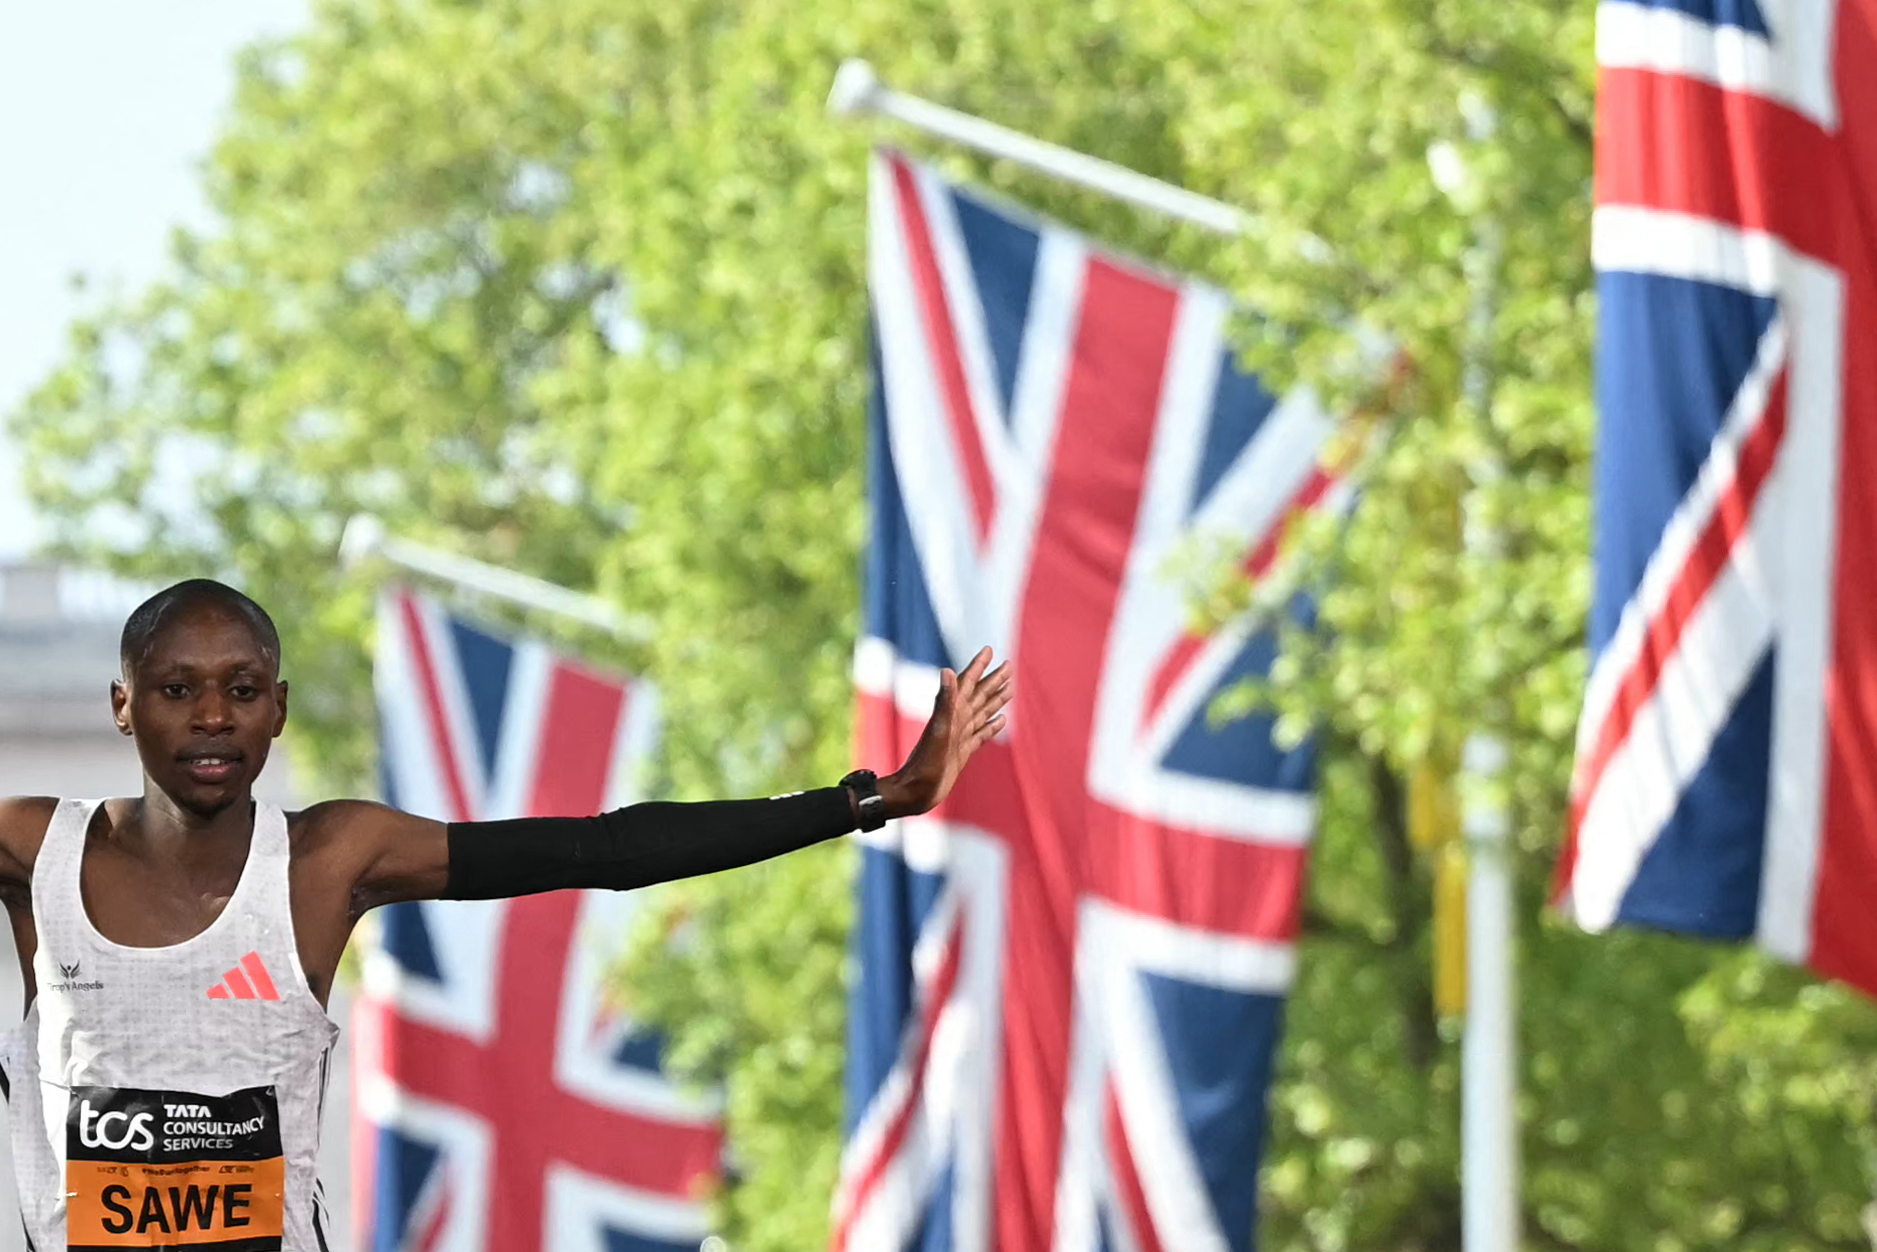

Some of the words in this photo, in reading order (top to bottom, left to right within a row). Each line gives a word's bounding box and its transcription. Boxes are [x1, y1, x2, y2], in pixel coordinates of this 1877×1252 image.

[163, 1104, 212, 1118] TATA
[79, 1099, 155, 1151] tcs
[163, 1115, 265, 1136] CONSULTANCY
[163, 1137, 234, 1152] SERVICES
[101, 1183, 253, 1235] SAWE
